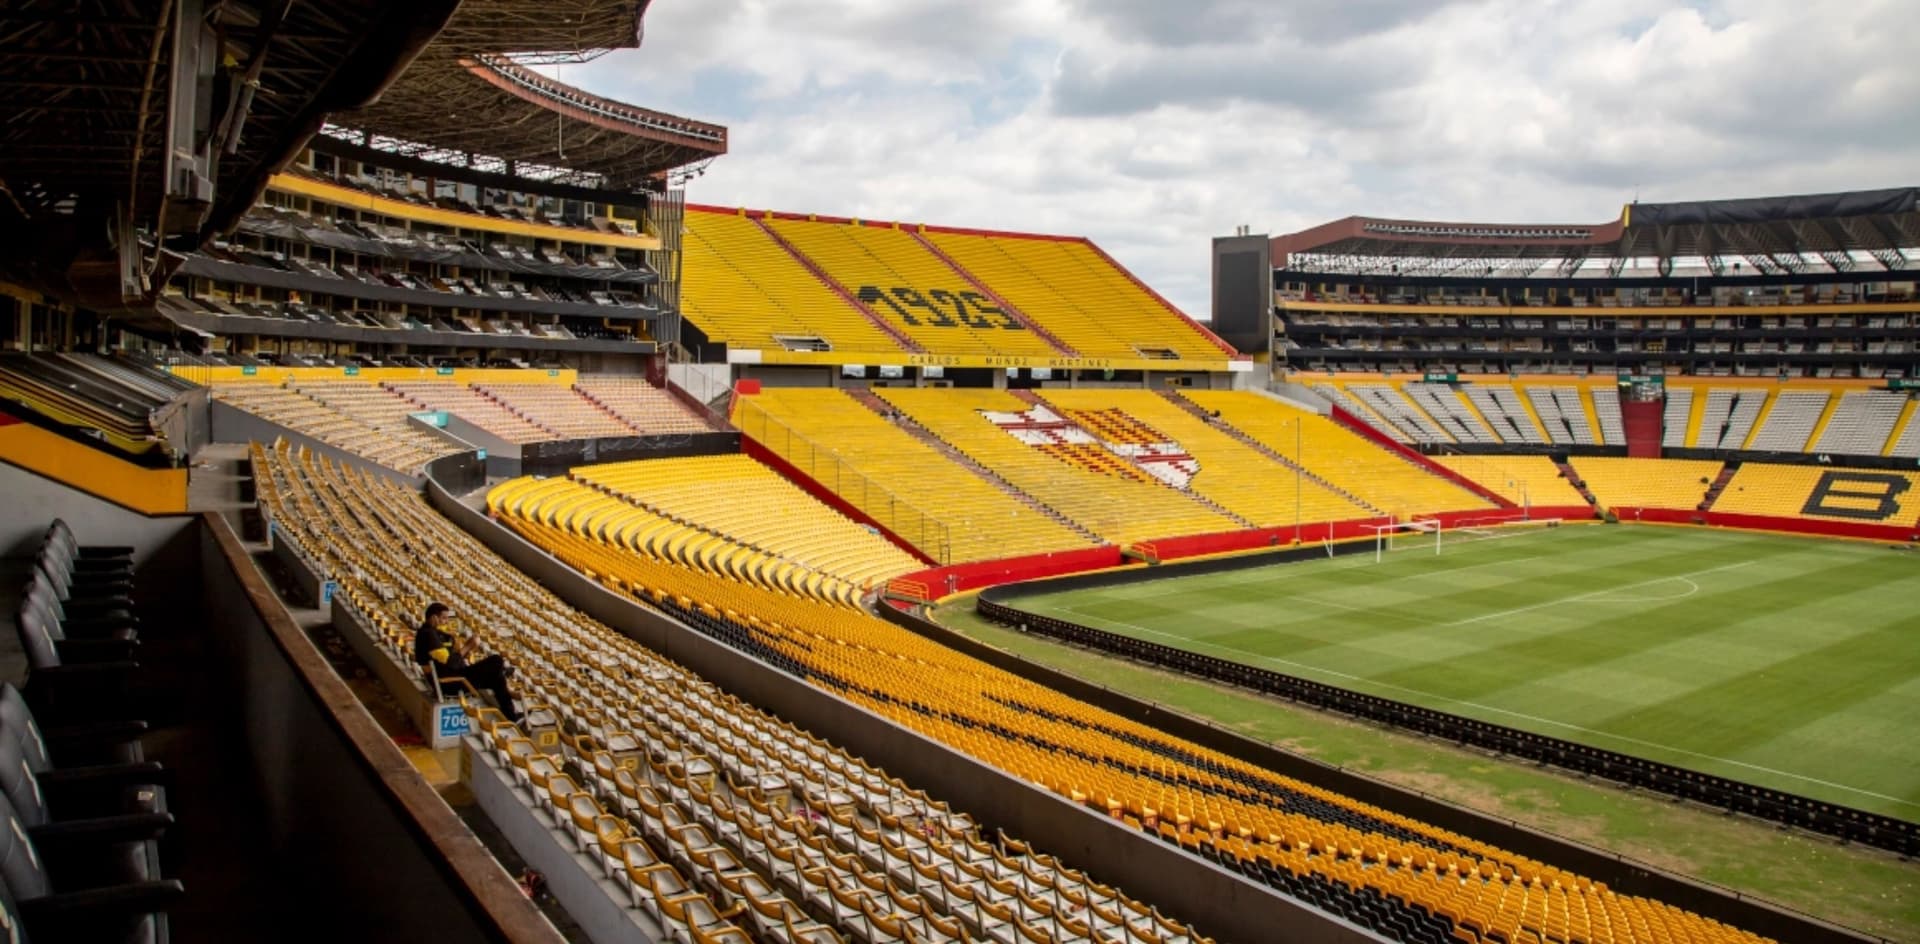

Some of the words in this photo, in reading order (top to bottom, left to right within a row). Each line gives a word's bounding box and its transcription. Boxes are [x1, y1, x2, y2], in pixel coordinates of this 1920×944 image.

[858, 286, 1026, 329] 1925
[910, 355, 961, 365] CARLOS
[1799, 470, 1912, 521] B
[442, 714, 468, 729] 706
